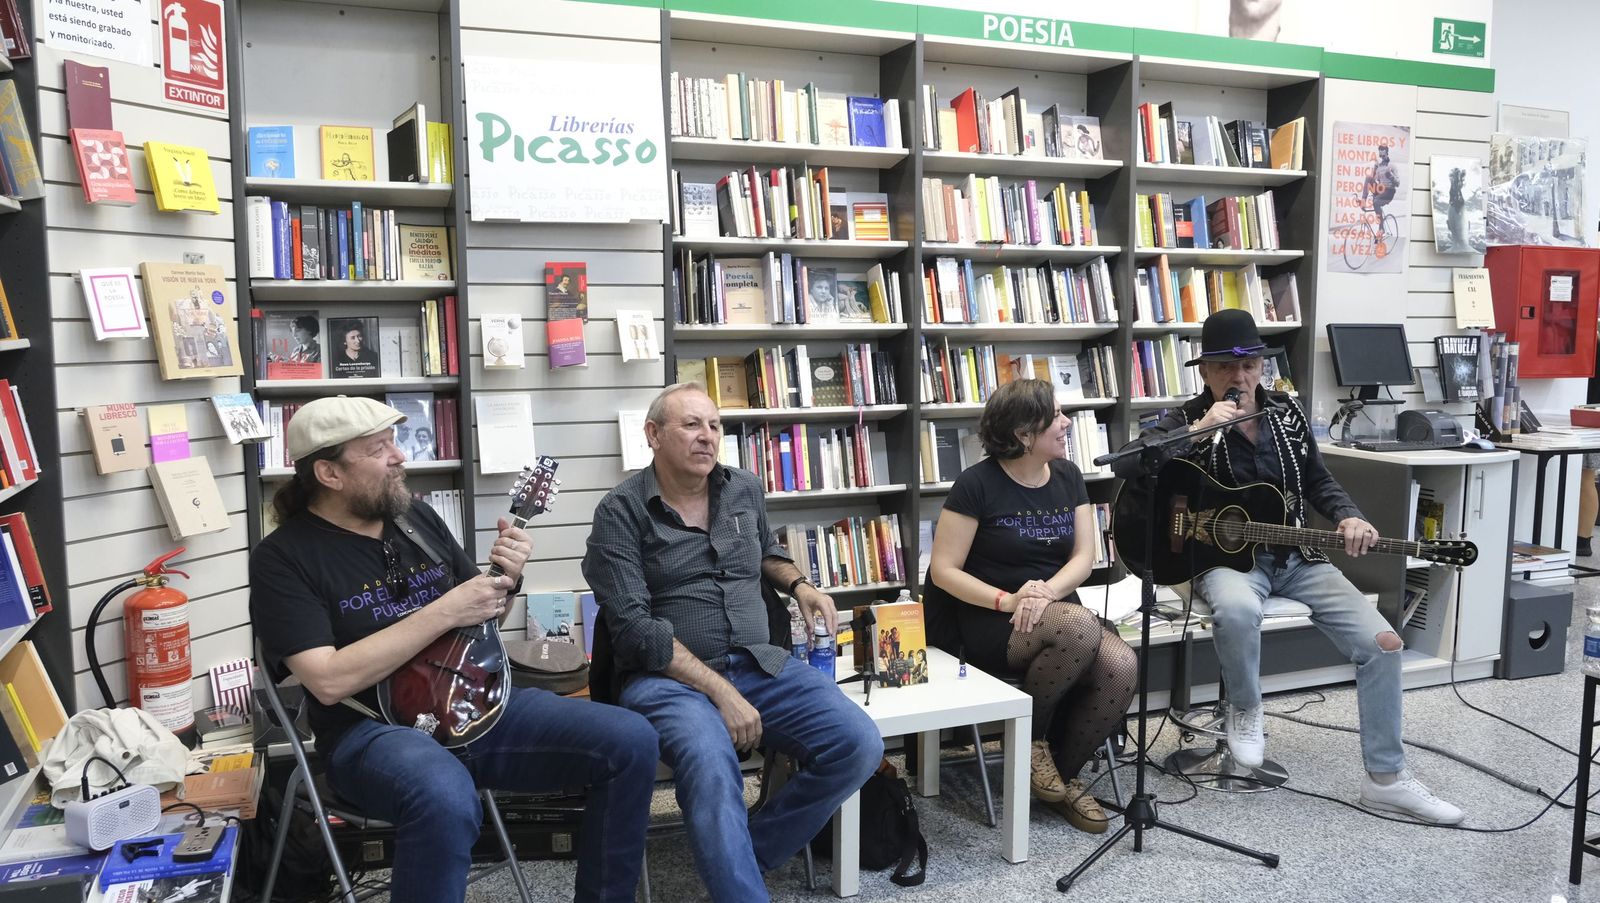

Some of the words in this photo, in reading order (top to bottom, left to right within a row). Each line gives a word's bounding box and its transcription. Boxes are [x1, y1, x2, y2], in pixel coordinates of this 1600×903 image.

[65, 0, 100, 14] nuestra,
[101, 7, 124, 19] usted
[49, 12, 68, 23] está
[69, 16, 97, 30] siendo
[98, 24, 132, 37] grabado
[982, 14, 1075, 47] POESÍA
[49, 30, 56, 39] y
[57, 31, 116, 50] monitorizado.
[169, 86, 221, 107] EXTINTOR
[548, 115, 635, 135] Librerías
[475, 112, 657, 167] Picasso
[1337, 133, 1354, 145] LEE
[1357, 134, 1396, 148] LIBROS
[1399, 137, 1406, 148] Y
[1337, 149, 1378, 162] MONTA
[1336, 165, 1351, 177] EN
[1336, 181, 1364, 193] PERO
[1367, 183, 1385, 194] NO
[1335, 196, 1373, 208] HAGAS
[1334, 212, 1356, 224] LAS
[1360, 213, 1380, 225] DOS
[1333, 229, 1371, 240] COSAS
[410, 242, 439, 250] Cartas
[1331, 244, 1346, 256] LA
[1350, 245, 1372, 256] VEZ
[162, 275, 179, 283] VISIÓN
[725, 272, 754, 280] Poesía
[724, 281, 759, 289] ompleta
[1442, 337, 1478, 354] RAYUELA
[106, 403, 136, 413] MUNDO
[98, 411, 138, 421] LIBRESCO
[1017, 506, 1069, 516] ADOLFO
[996, 517, 1022, 527] POR
[1025, 516, 1040, 527] EL
[339, 591, 375, 616] POR
[376, 584, 392, 602] EL
[372, 586, 441, 622] PÚRPURA
